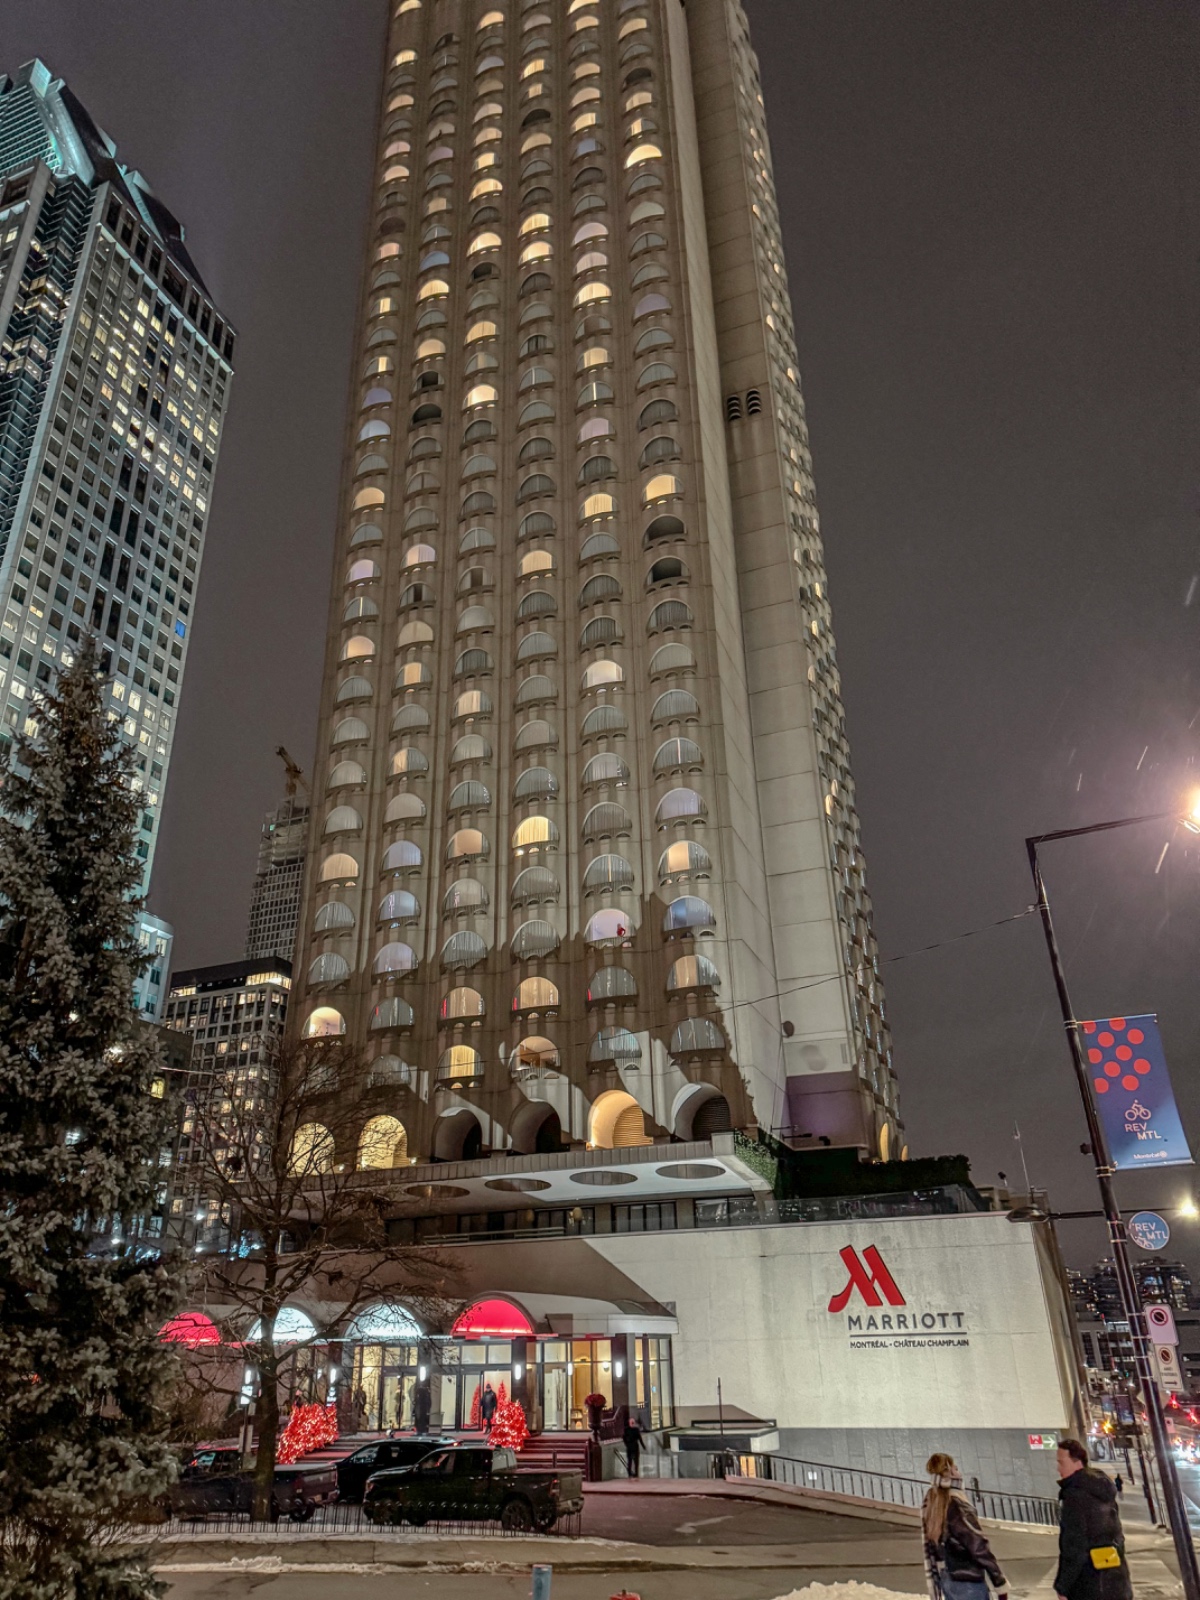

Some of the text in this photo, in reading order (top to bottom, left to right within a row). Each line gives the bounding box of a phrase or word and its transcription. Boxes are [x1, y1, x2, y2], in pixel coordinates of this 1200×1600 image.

[1125, 1122, 1147, 1132] REV
[1137, 1130, 1162, 1140] MTL
[1135, 1222, 1156, 1231] REV
[1146, 1231, 1169, 1240] MTL
[848, 1312, 964, 1331] MARRIOTT
[850, 1338, 969, 1349] MONTRÉAL CHÂTEAU CHAMPLAIN
